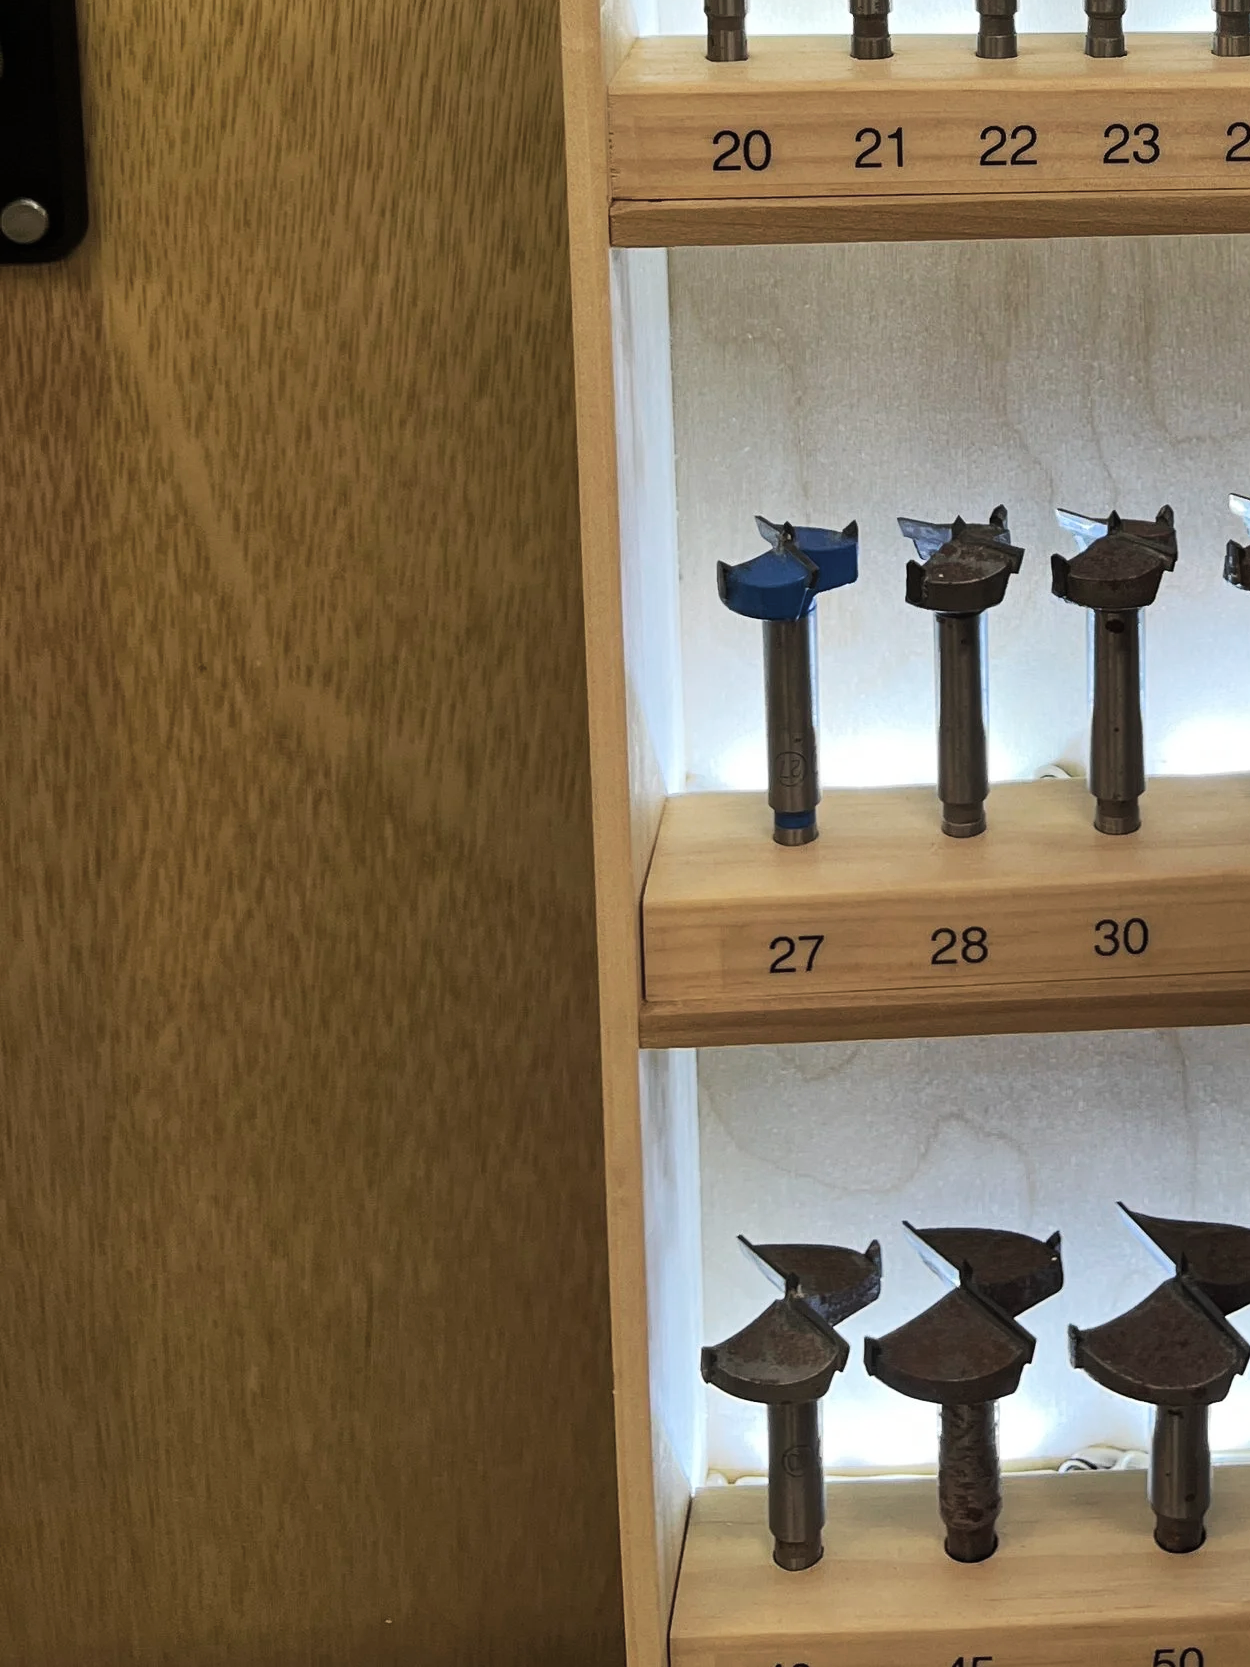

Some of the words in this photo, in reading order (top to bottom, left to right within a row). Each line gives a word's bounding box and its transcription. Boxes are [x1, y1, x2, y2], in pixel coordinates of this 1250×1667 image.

[713, 130, 772, 172] 20
[855, 127, 904, 169] 21
[980, 125, 1038, 167] 22
[1103, 123, 1161, 165] 23
[769, 935, 825, 974] 27
[931, 927, 989, 966] 28
[1094, 918, 1149, 957] 30
